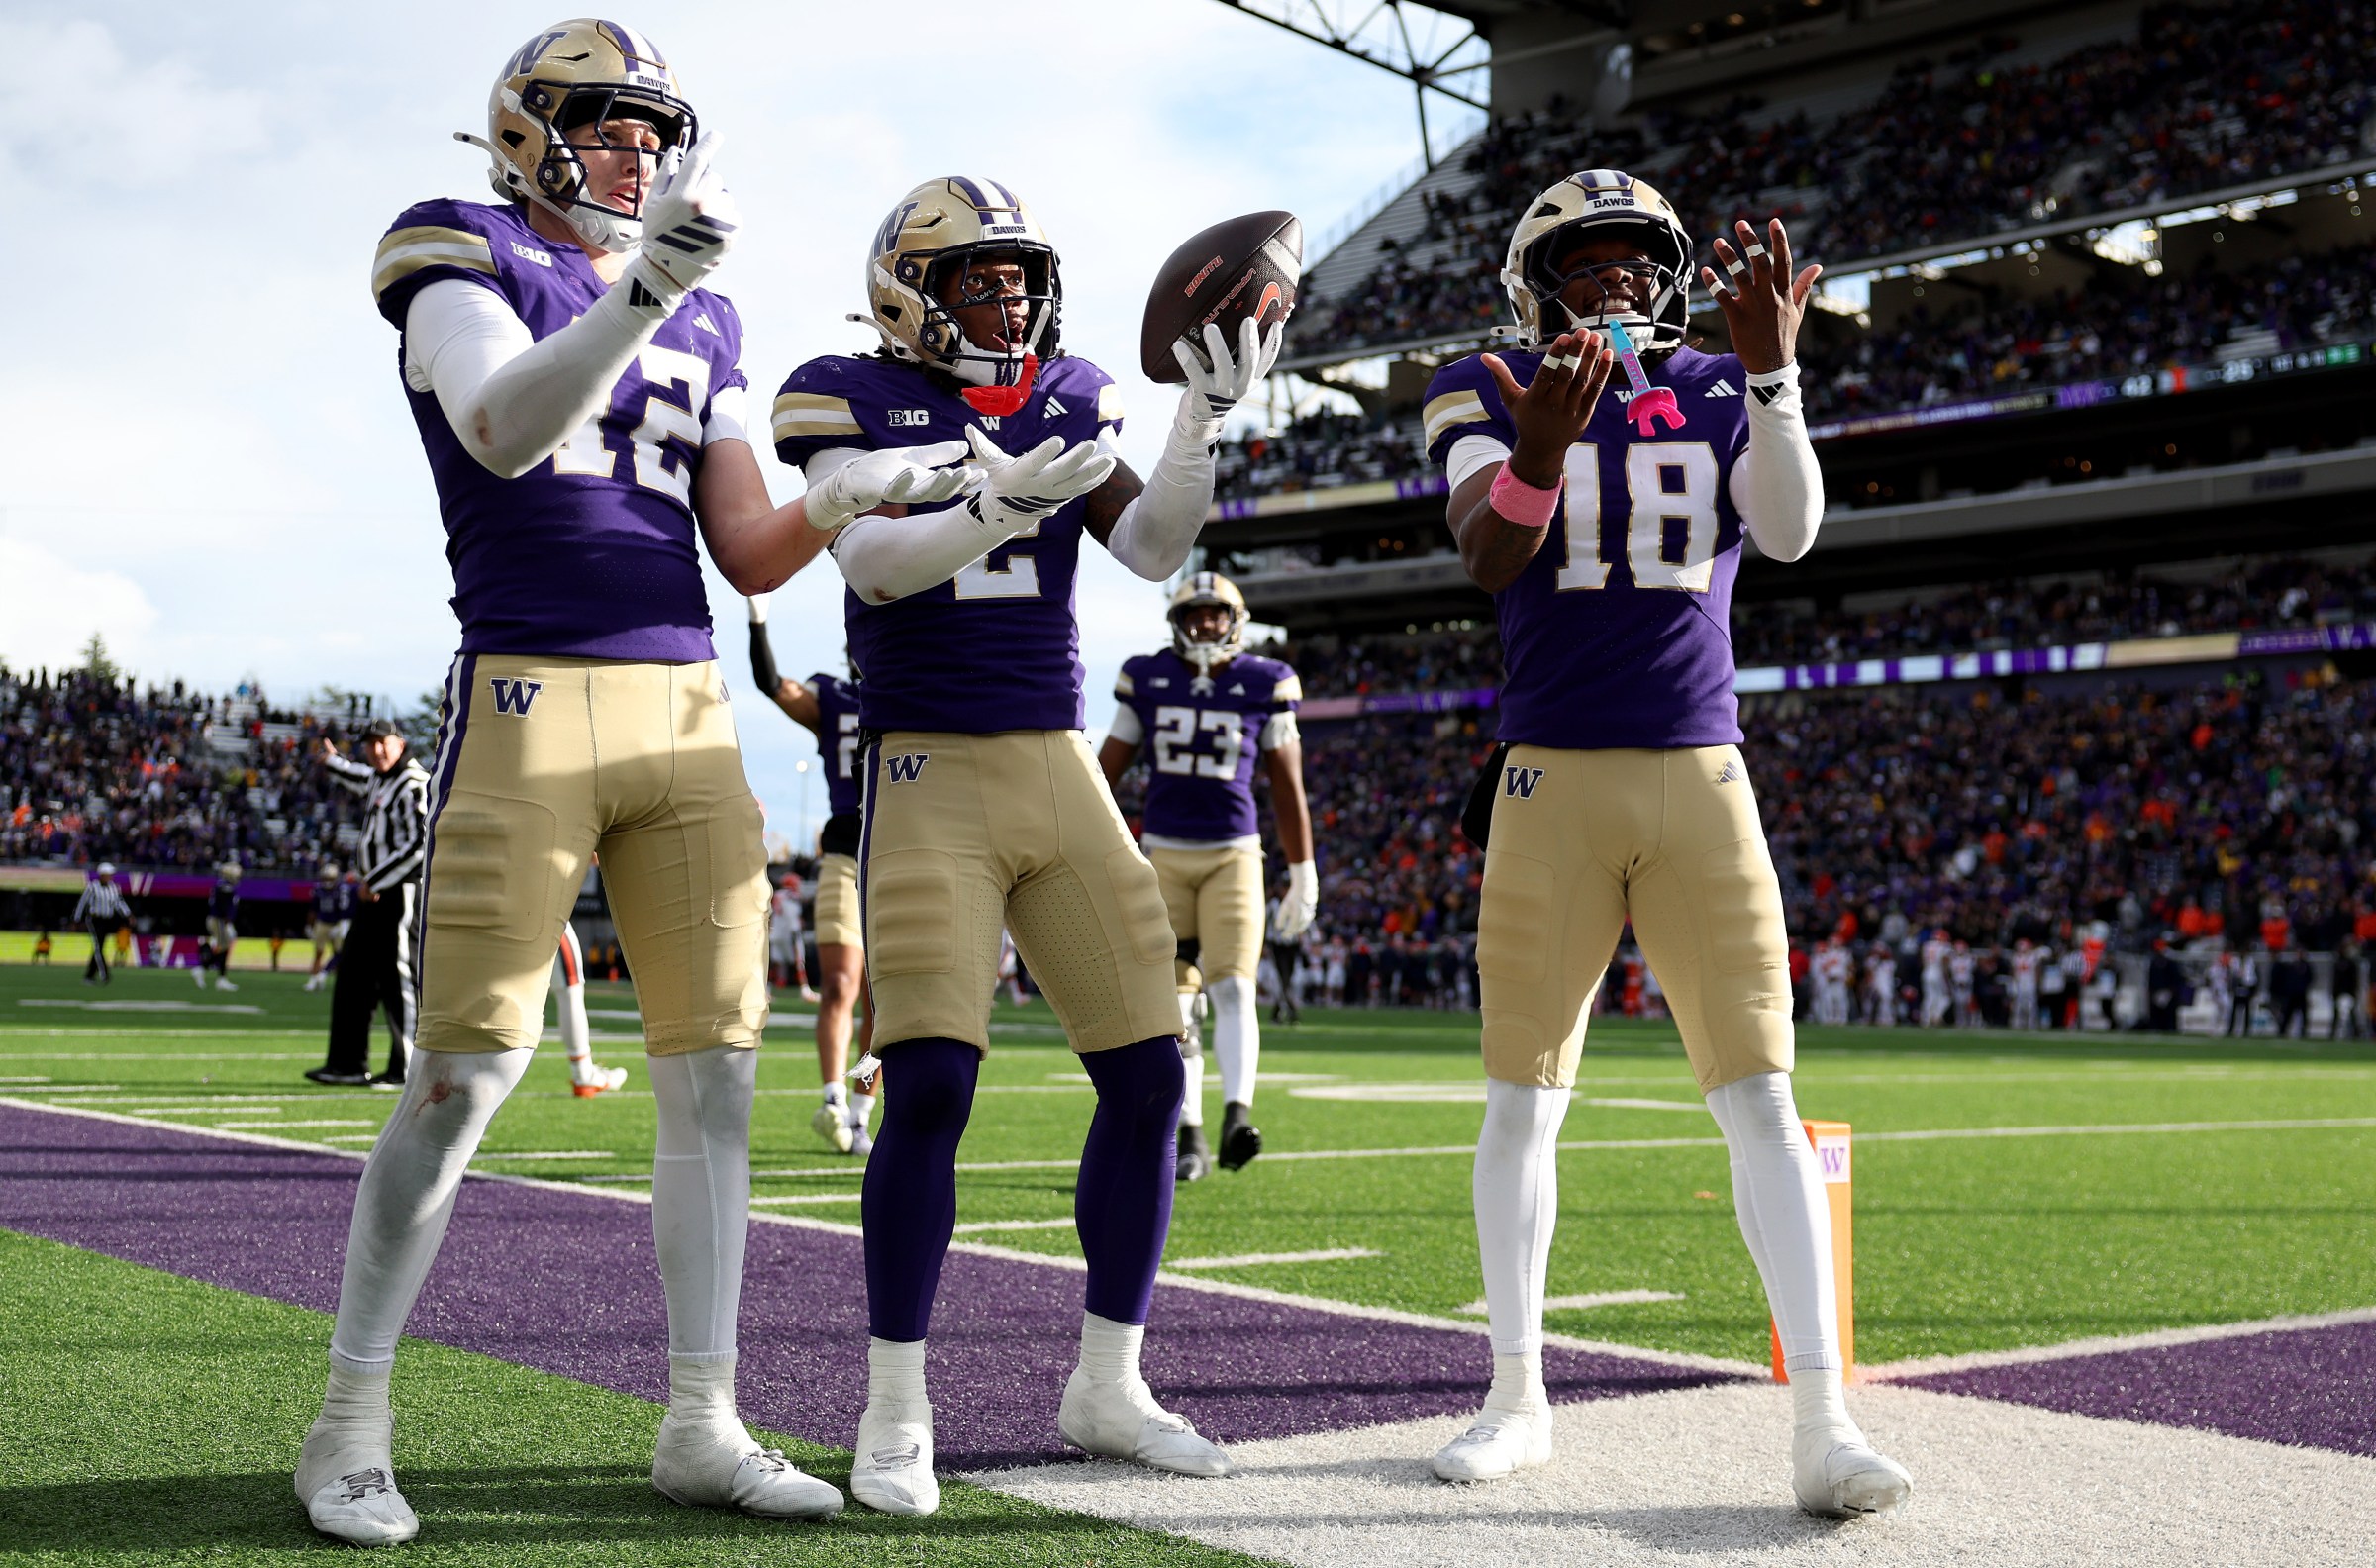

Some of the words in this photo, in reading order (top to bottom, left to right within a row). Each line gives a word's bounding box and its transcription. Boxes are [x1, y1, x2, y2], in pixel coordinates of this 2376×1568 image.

[637, 75, 670, 90] DAWGS
[1592, 197, 1635, 209] DAWGS
[873, 201, 921, 262] W
[991, 225, 1027, 235] DAWGS
[979, 416, 1001, 431] W
[1555, 441, 1720, 594] 18
[490, 677, 544, 718] W
[1154, 705, 1243, 782] 23
[886, 753, 930, 783] W
[1506, 765, 1544, 799] W
[1821, 1147, 1845, 1174] W
